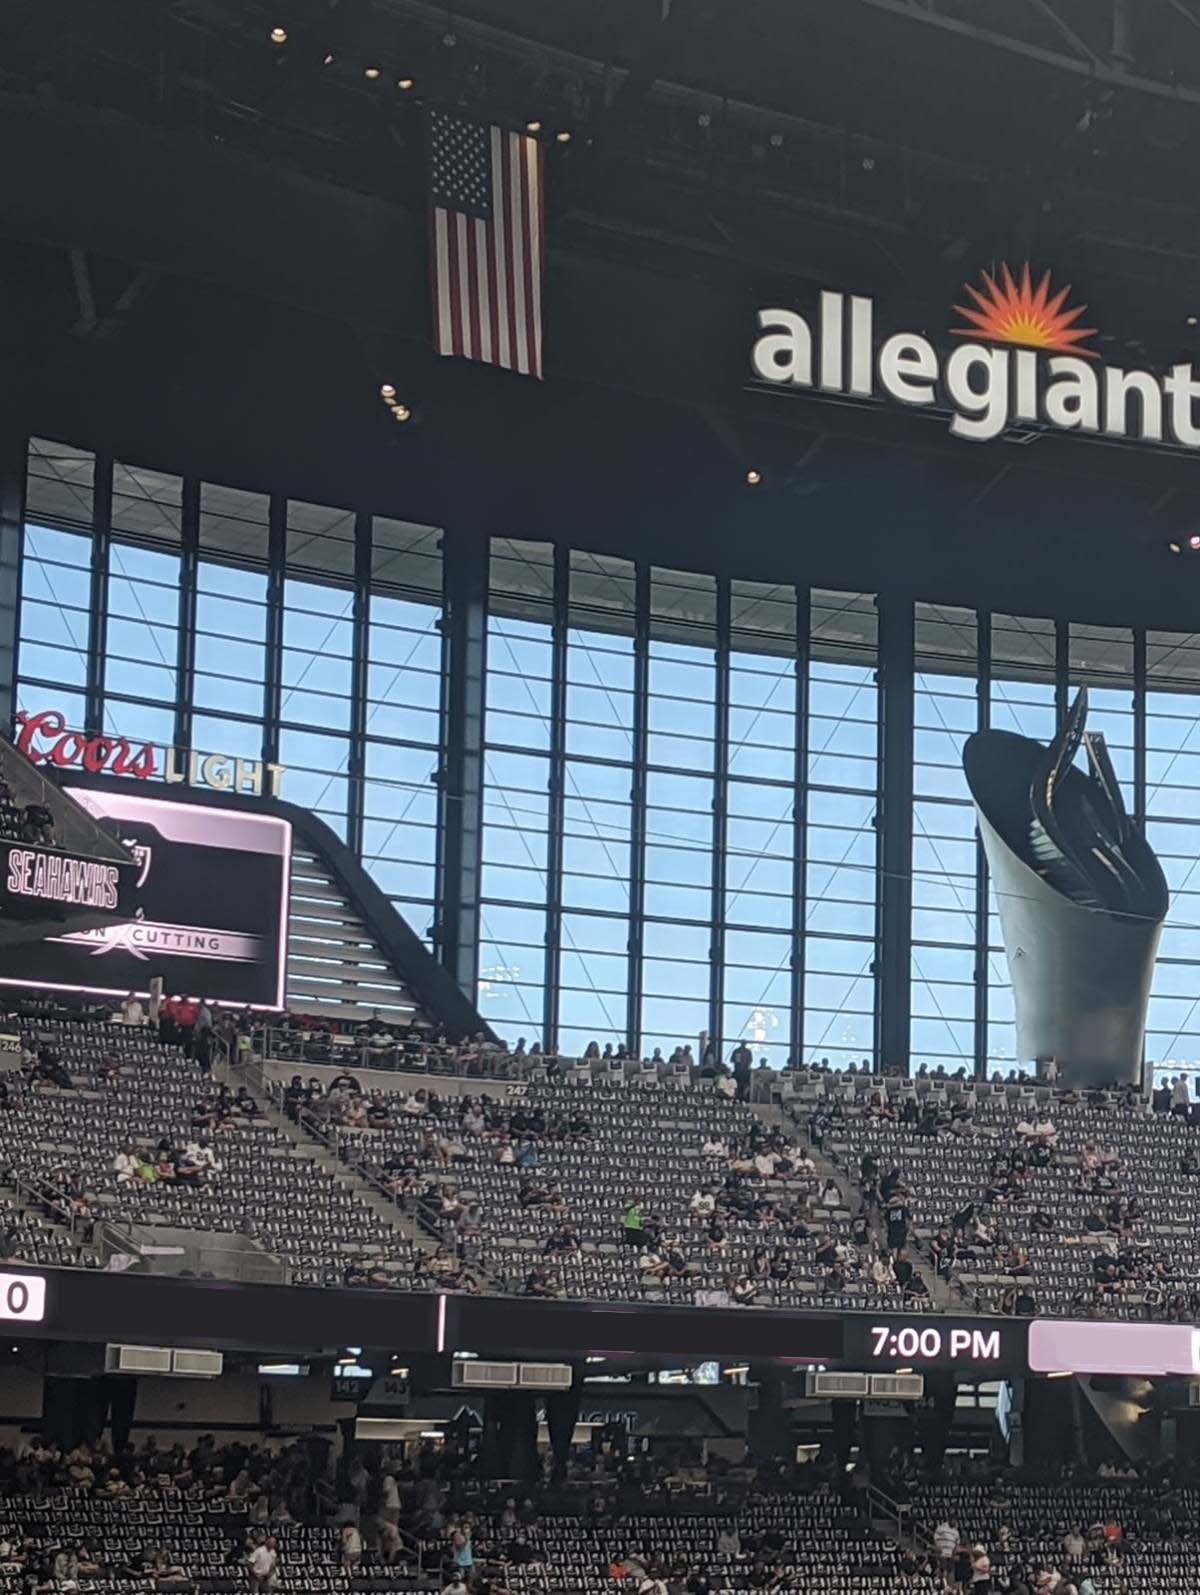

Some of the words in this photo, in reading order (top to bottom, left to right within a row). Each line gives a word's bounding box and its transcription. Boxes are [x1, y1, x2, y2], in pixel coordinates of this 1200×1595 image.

[15, 710, 157, 779] Coors
[164, 747, 286, 797] LIGHT
[7, 849, 119, 909] SEAHAWKS
[132, 929, 220, 950] CUTTING
[7, 1281, 29, 1313] 0
[871, 1327, 941, 1357] 7:00
[950, 1329, 1000, 1359] PM
